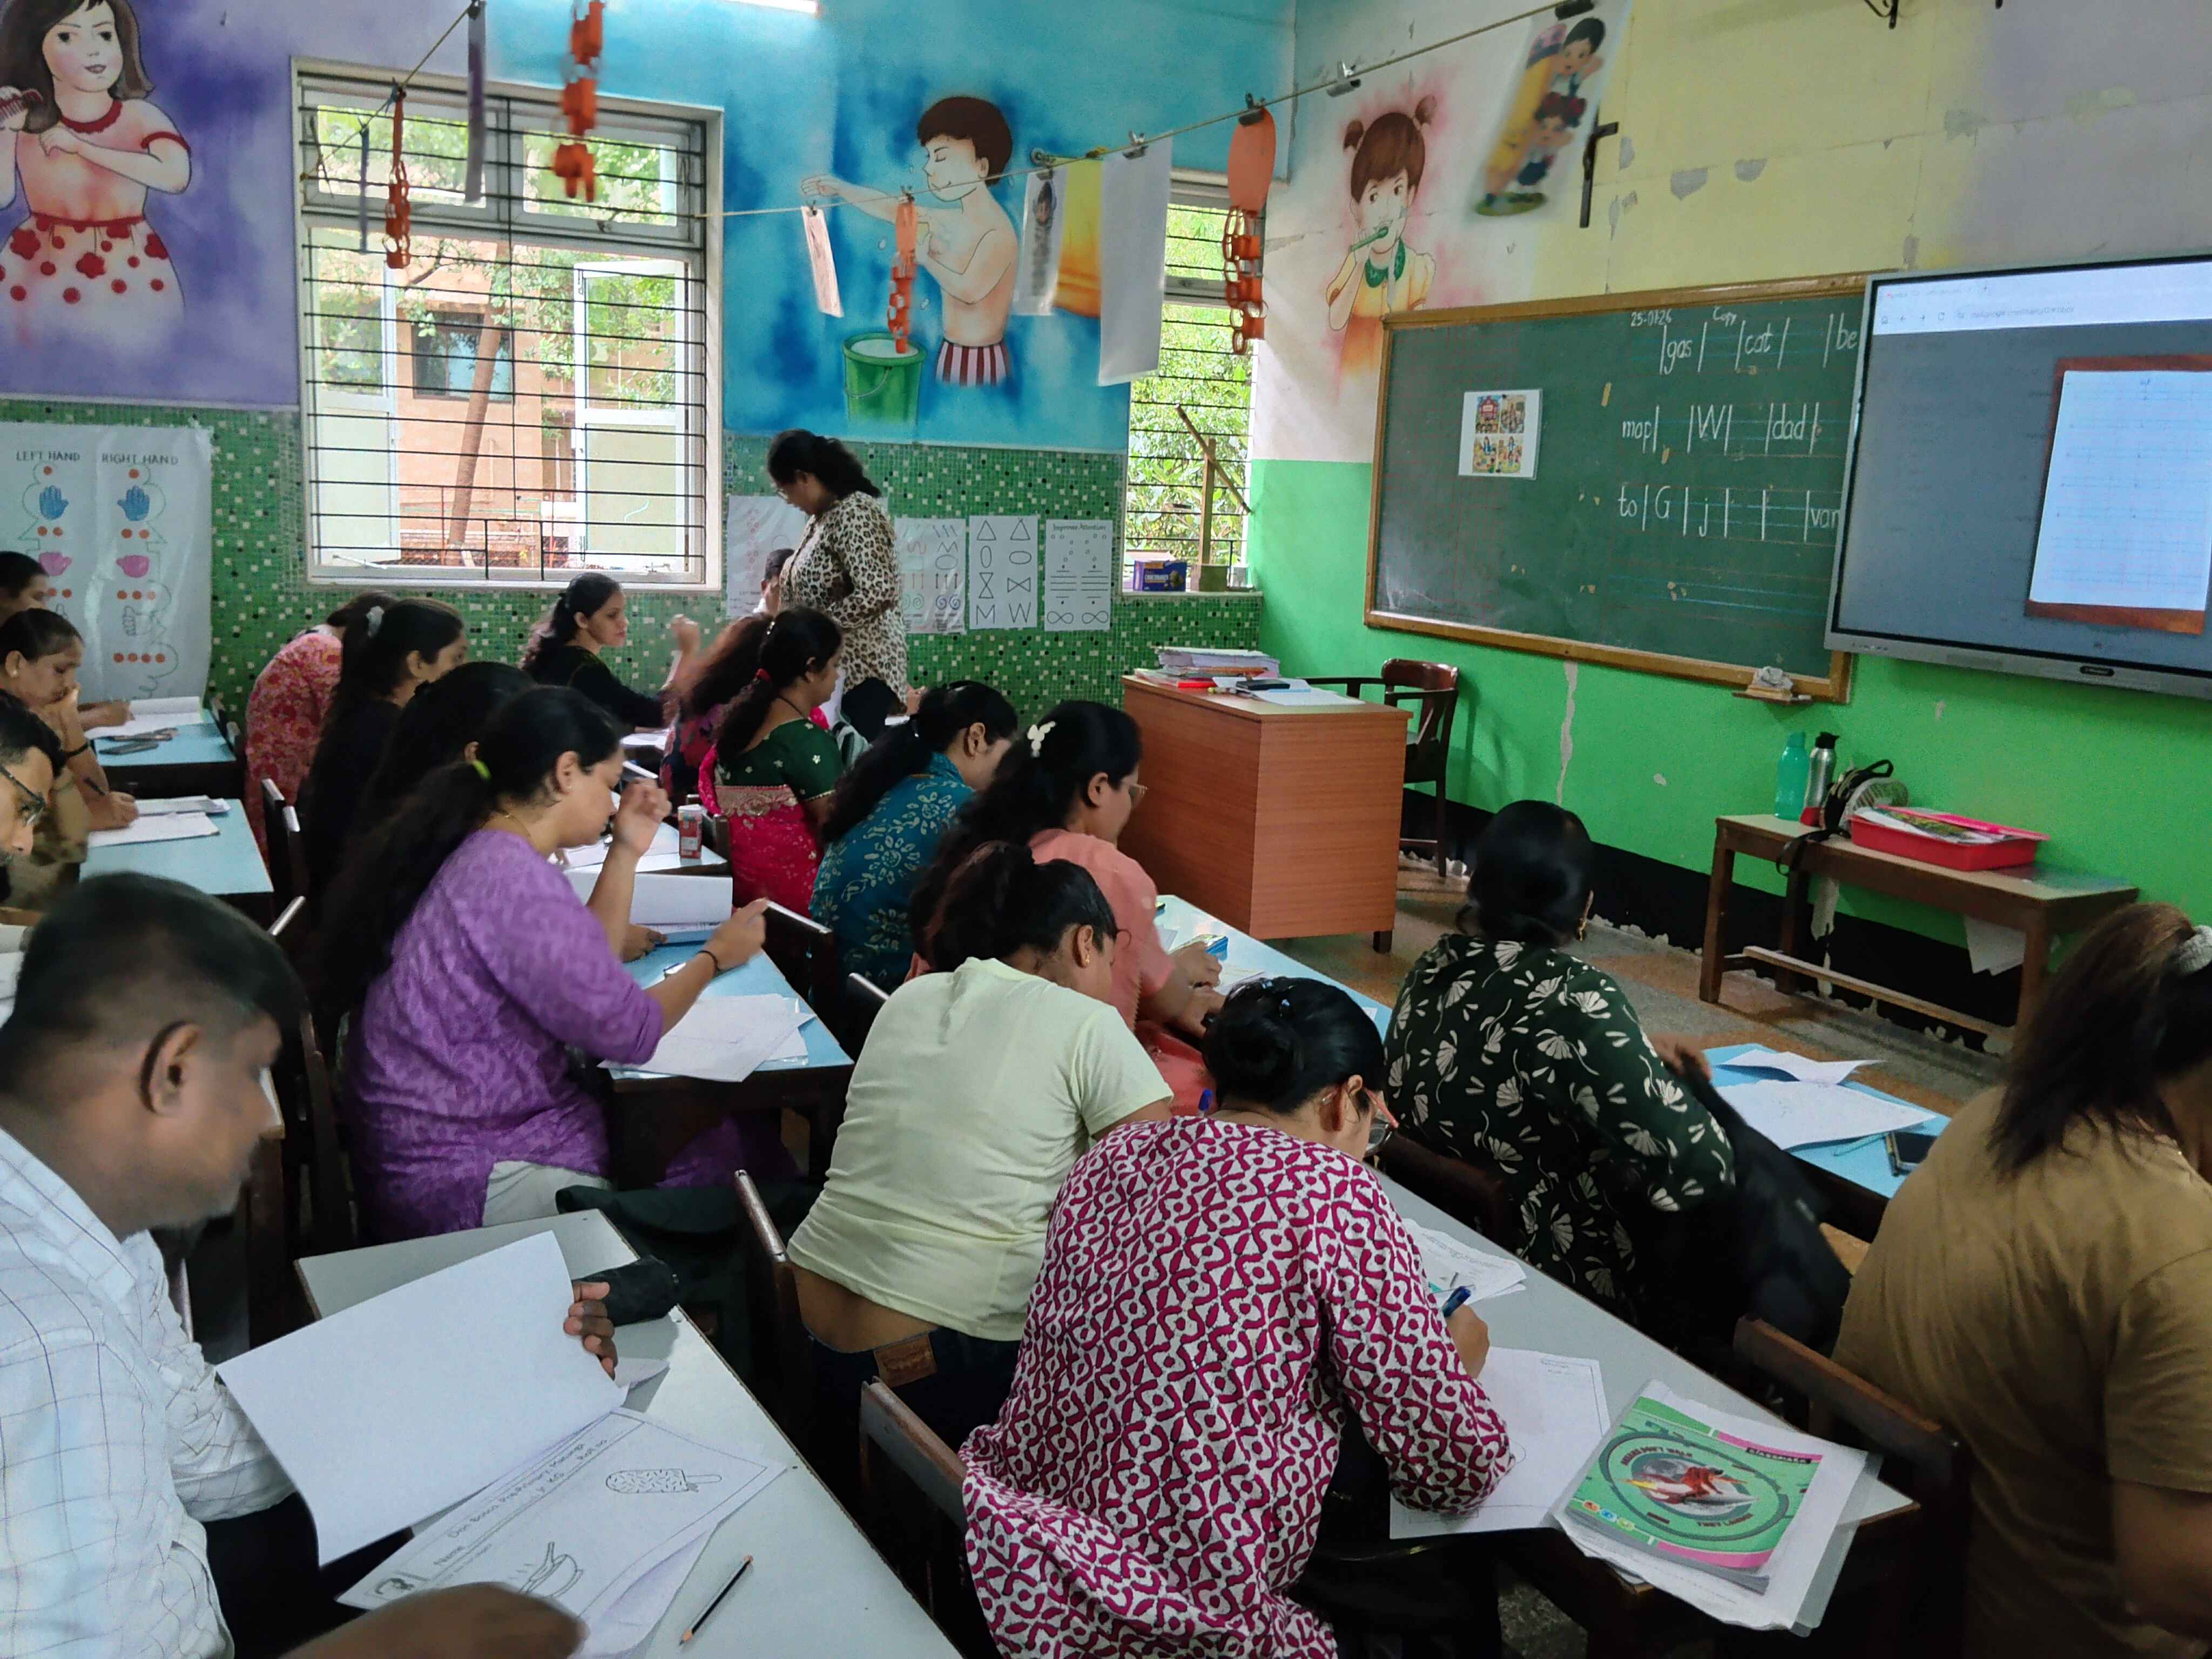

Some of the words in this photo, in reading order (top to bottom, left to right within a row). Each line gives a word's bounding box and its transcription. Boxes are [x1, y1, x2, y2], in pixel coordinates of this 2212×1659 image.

[1664, 340, 1692, 375] gas
[1745, 322, 1773, 354] cat
[1622, 420, 1651, 454] mop
[1698, 404, 1727, 440] W
[1772, 402, 1806, 440] dad
[16, 451, 43, 462] LEFT
[48, 451, 80, 462] HAND
[101, 453, 138, 464] RIGHT
[141, 454, 179, 466] HAND
[1618, 483, 1637, 517] to
[1655, 485, 1671, 520] G
[1699, 497, 1709, 537] j
